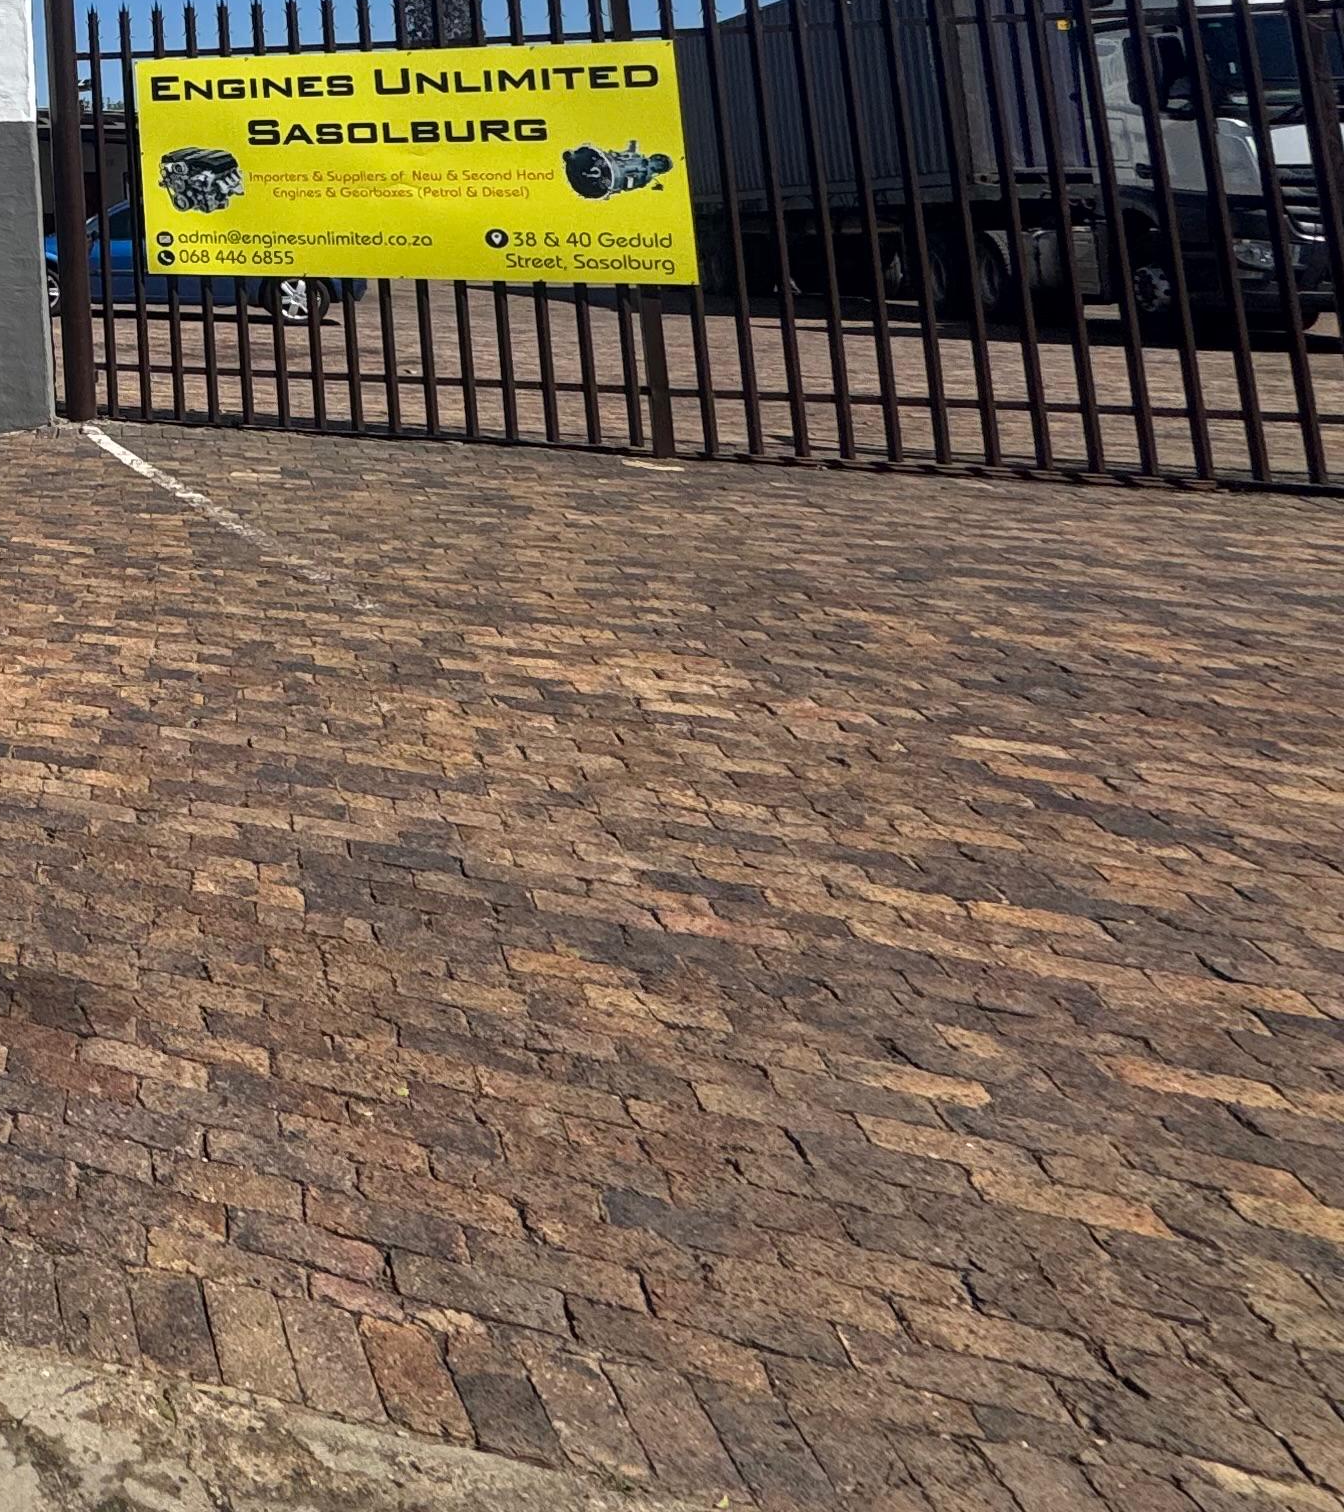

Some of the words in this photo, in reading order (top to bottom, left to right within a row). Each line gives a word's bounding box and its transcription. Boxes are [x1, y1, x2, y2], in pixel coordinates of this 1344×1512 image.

[150, 74, 354, 102] ENGINES
[374, 64, 659, 95] UNLIMITED
[247, 118, 548, 146] SASOLBURG
[248, 171, 309, 184] Importers
[312, 171, 323, 182] &
[327, 171, 387, 184] Suppliers
[391, 171, 405, 182] of
[412, 170, 442, 181] New
[447, 170, 458, 181] &
[462, 169, 512, 181] Second
[517, 169, 554, 181] Hand
[273, 187, 322, 201] Engines
[326, 187, 337, 198] &
[340, 187, 413, 199] Gearboxes
[417, 186, 462, 199] (Petrol
[466, 186, 477, 198] &
[482, 186, 530, 199] Diesel)
[178, 230, 433, 248] admin@enginesunlimited.co.za
[513, 231, 537, 248] 38
[544, 232, 560, 248] &
[566, 232, 592, 248] 40
[598, 232, 673, 248] Geduld
[179, 249, 211, 264] 068
[215, 249, 248, 265] 446
[252, 250, 295, 265] 6855
[505, 253, 568, 271] Street,
[573, 254, 676, 276] Sasolburg
